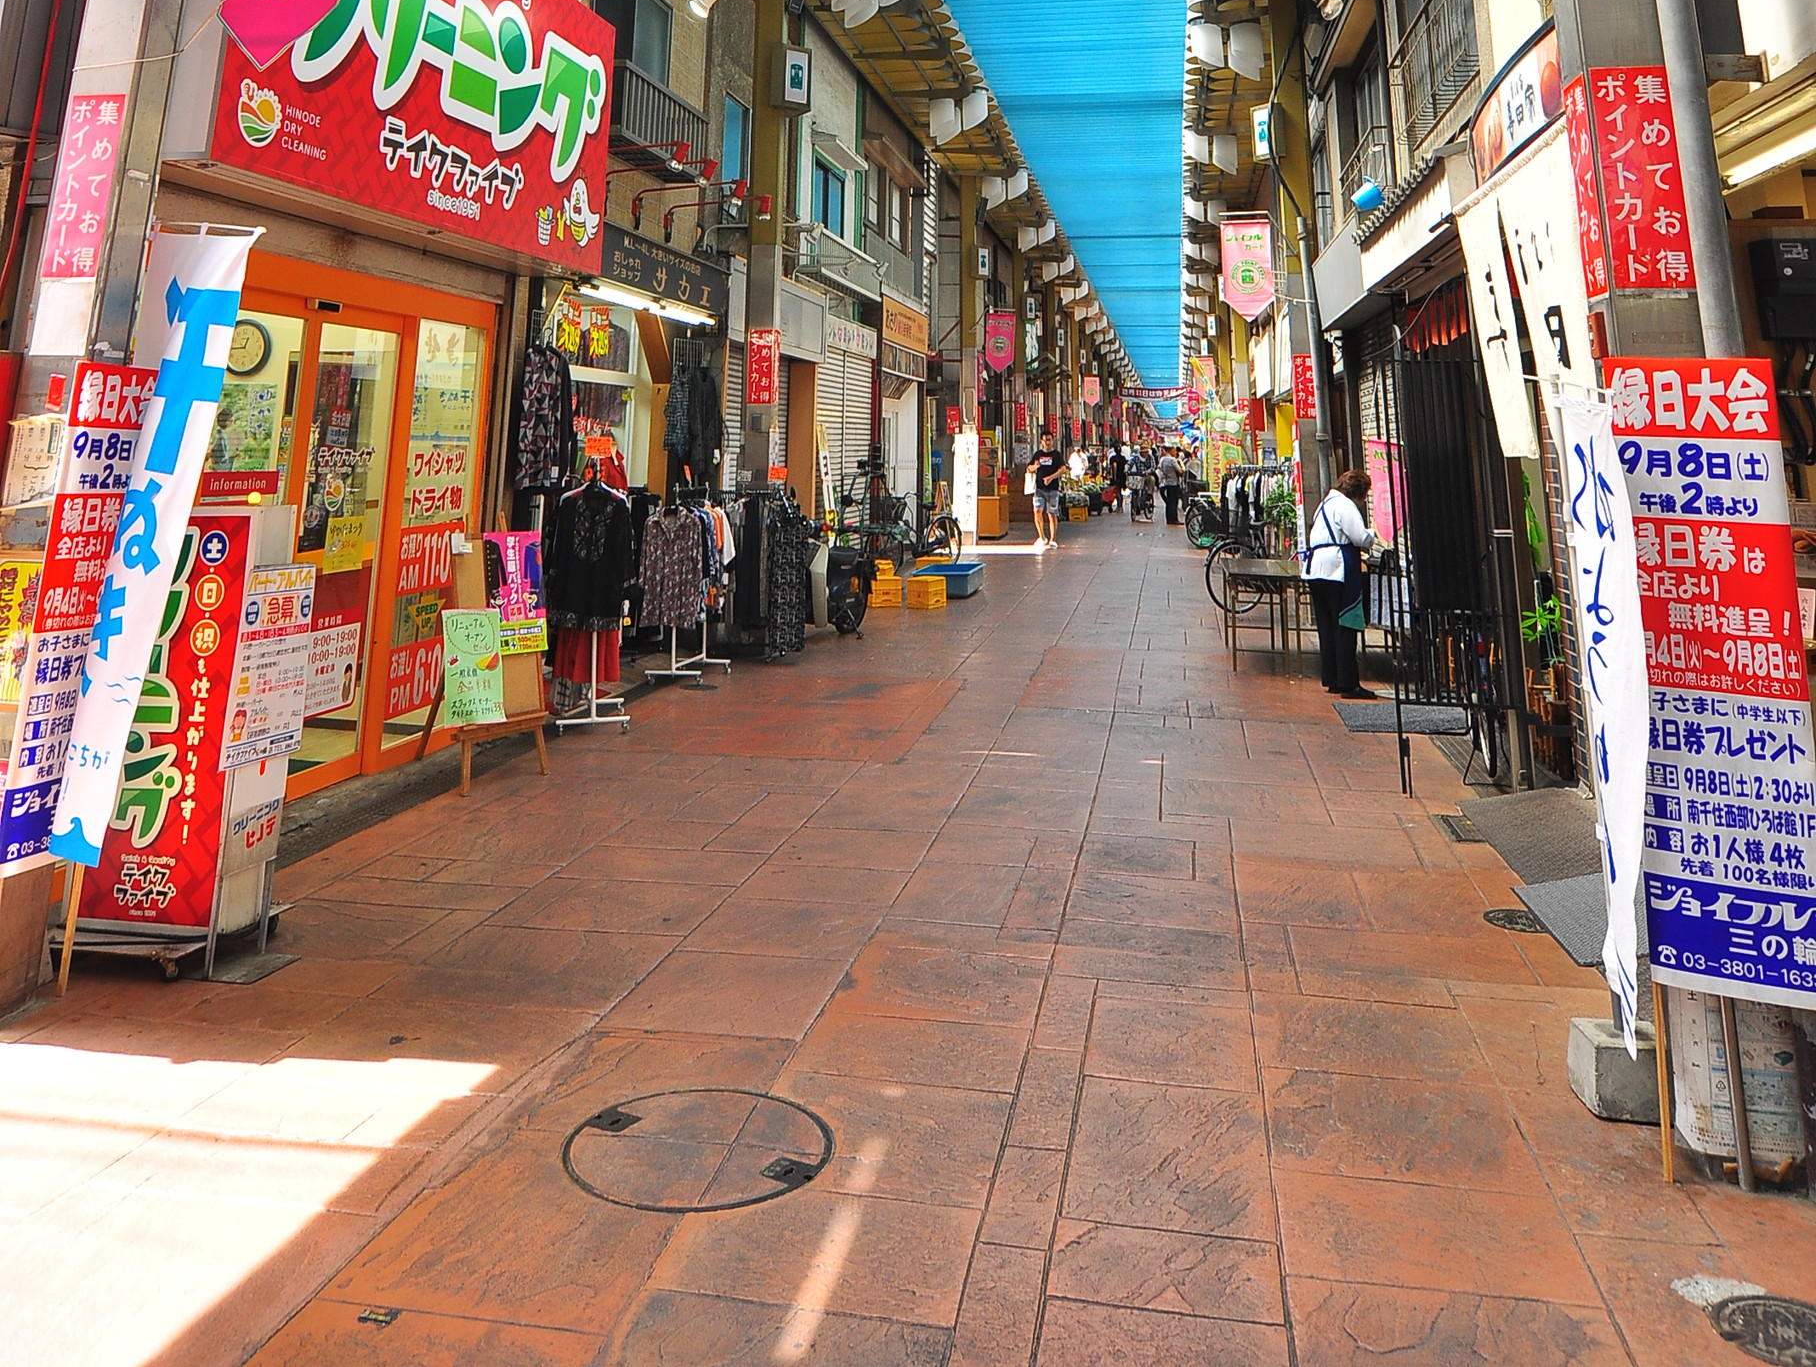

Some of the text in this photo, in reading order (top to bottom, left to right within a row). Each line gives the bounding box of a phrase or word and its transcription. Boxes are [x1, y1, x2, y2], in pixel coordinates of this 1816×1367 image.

[283, 120, 303, 137] DRY
[285, 104, 322, 128] HINODE
[281, 136, 327, 161] CLEANING
[379, 115, 525, 210] テイクファイブ
[52, 100, 96, 273] ポイントカード
[72, 100, 120, 273] 集めてお得
[1564, 90, 1595, 292] ポイントカード
[1573, 85, 1606, 287] 集めてお得
[1597, 73, 1651, 284] ポイントカード
[1635, 75, 1691, 283] 集めてお得
[612, 263, 641, 282] ショップ
[613, 251, 642, 270] おしゃれ
[652, 266, 712, 307] サカエ
[1611, 367, 1770, 434] 縁日大会
[413, 450, 466, 478] ワイシャツ
[209, 477, 267, 491] information
[1638, 481, 1760, 517] 午後2時より
[410, 484, 464, 517] ドライ物
[54, 534, 107, 561] 全店より
[398, 564, 419, 592] AM
[267, 595, 295, 625] 急募
[415, 602, 438, 618] SPEED
[421, 616, 433, 630] UP
[312, 628, 358, 649] 9:00~19:00
[1647, 667, 1802, 698] 切れの際はお許しください)
[389, 682, 410, 714] PM
[10, 783, 62, 819] ジョイ
[233, 798, 280, 836] クリーニング
[245, 815, 277, 849] ヒノデ
[121, 863, 170, 889] テイク
[1680, 856, 1715, 878] 先着
[114, 883, 176, 908] ファイブ
